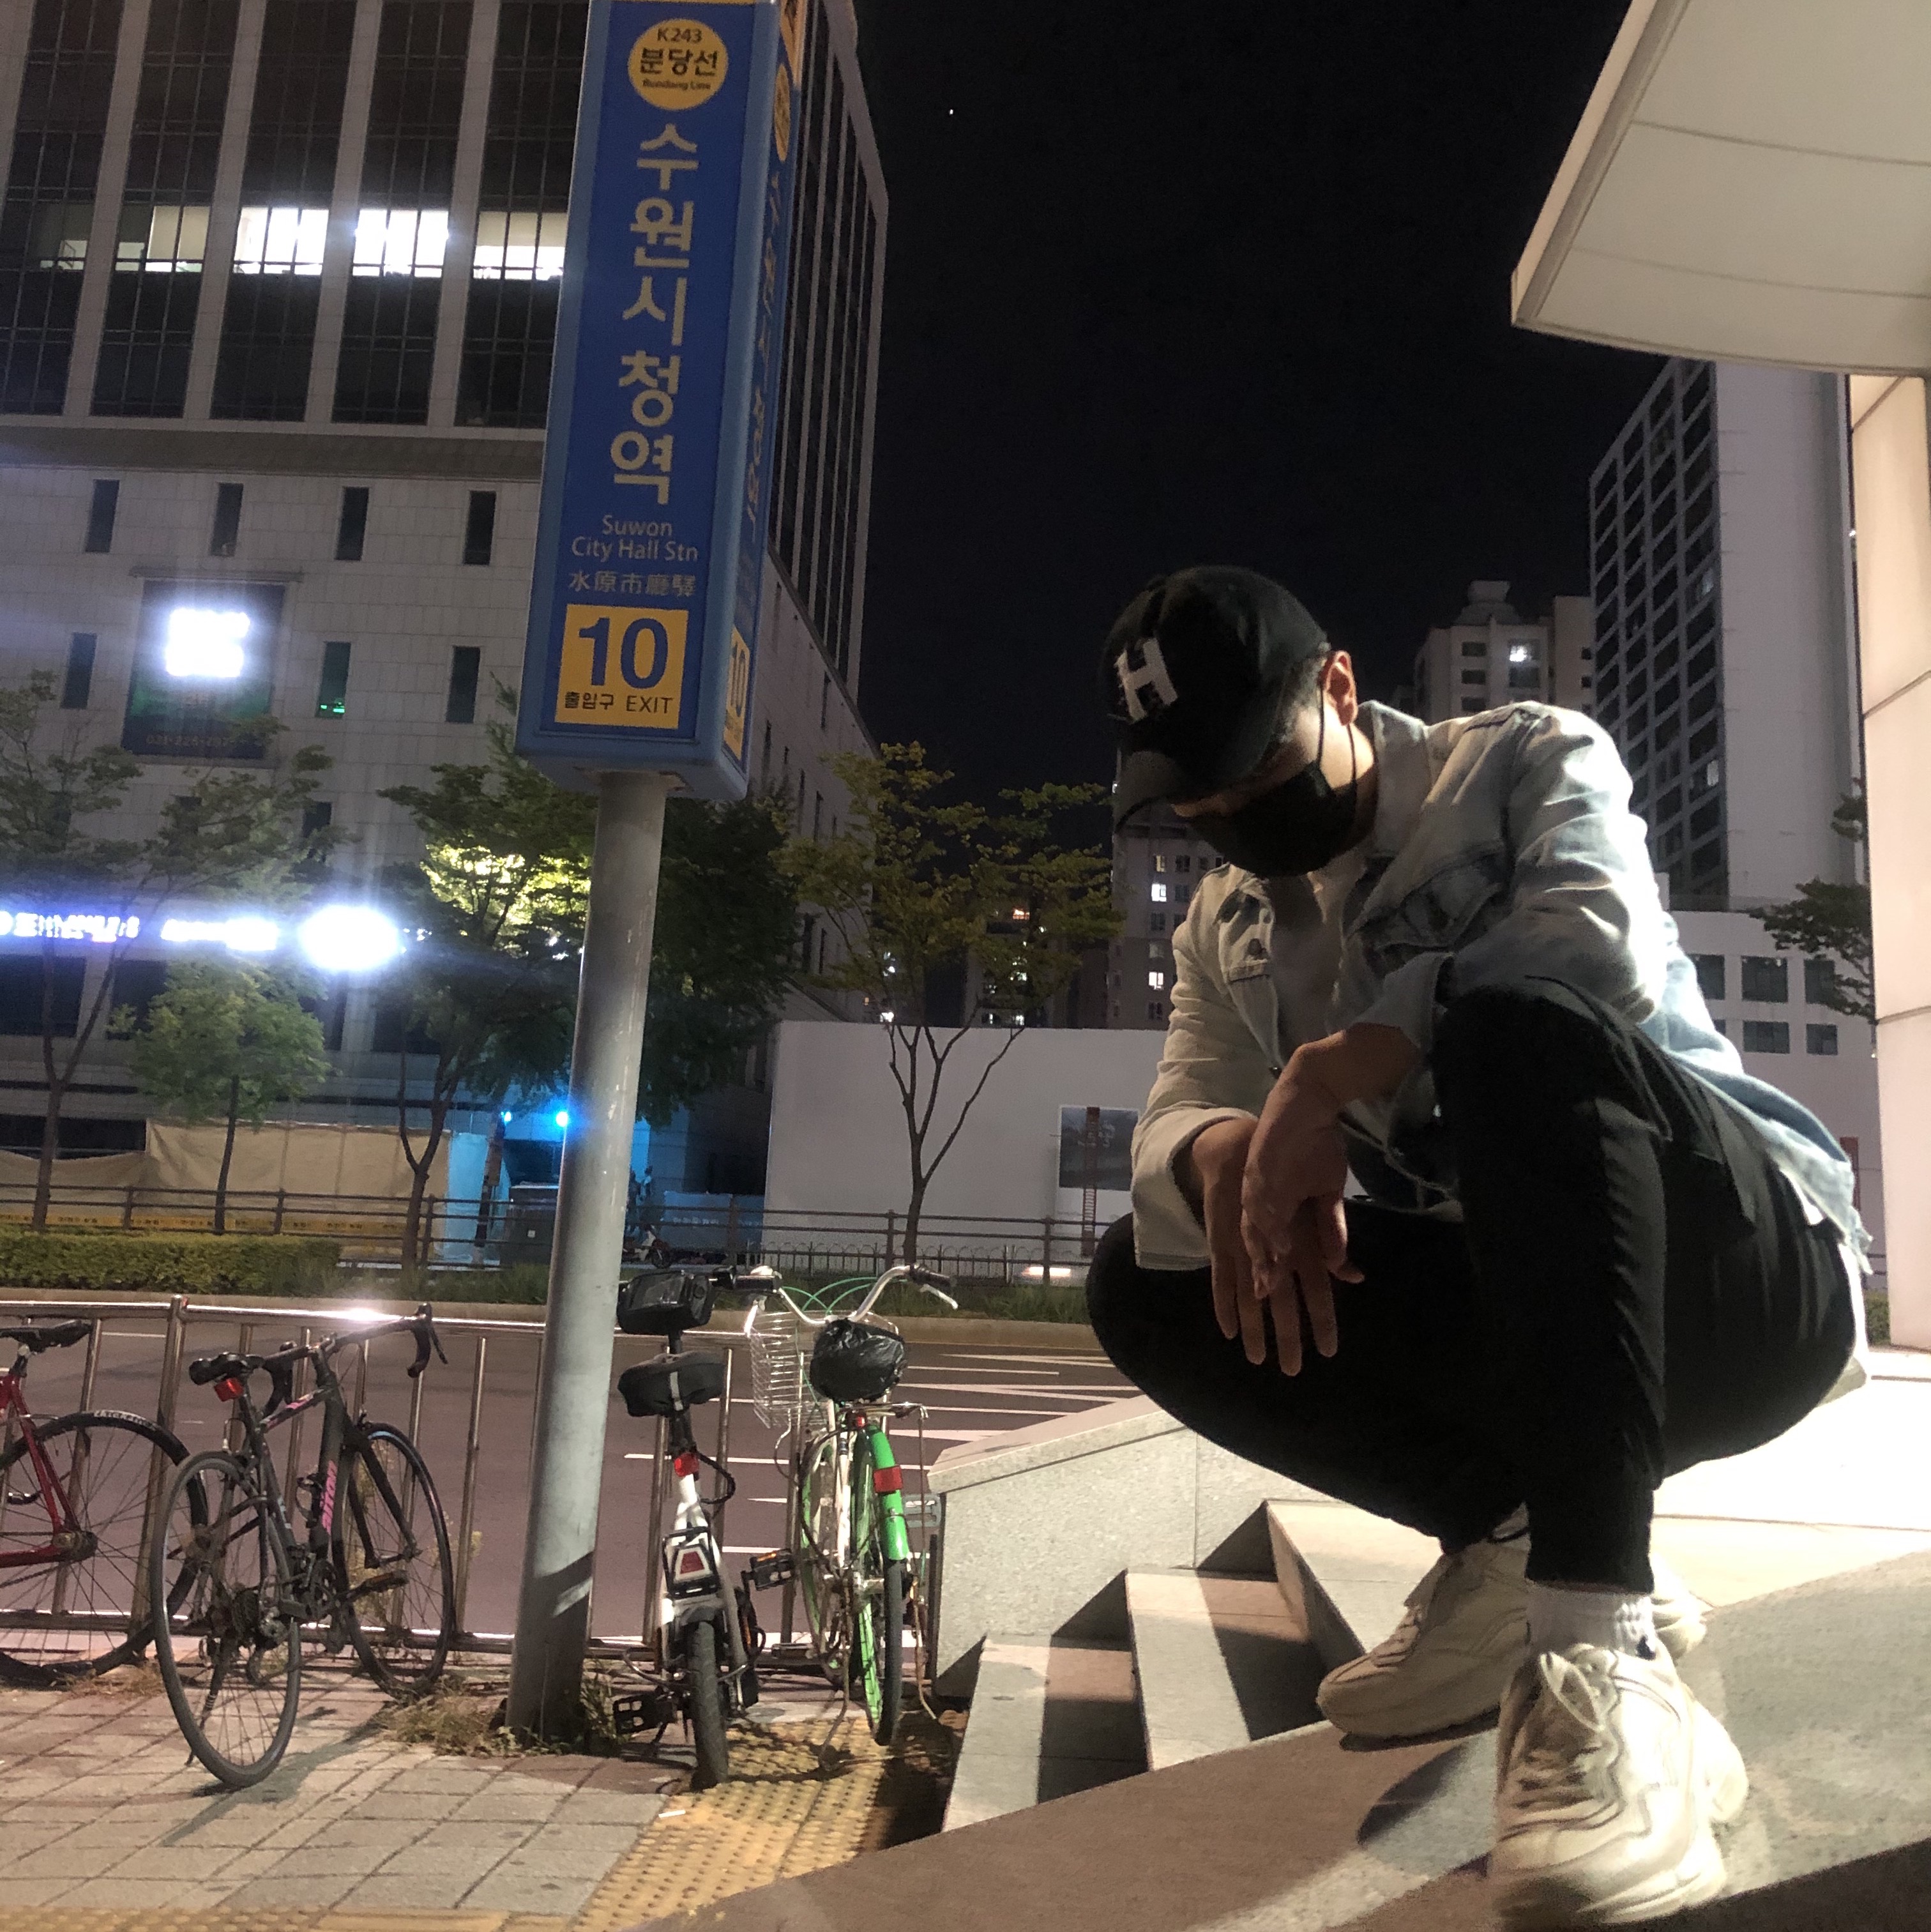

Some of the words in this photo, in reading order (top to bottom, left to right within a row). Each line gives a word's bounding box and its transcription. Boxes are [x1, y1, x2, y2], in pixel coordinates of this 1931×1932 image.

[657, 27, 702, 43] K243
[640, 47, 718, 76] 분당선
[610, 123, 699, 505] 수원시청역
[602, 514, 672, 536] Suwon
[572, 536, 613, 562] City
[618, 538, 660, 559] Hall
[664, 541, 698, 561] Stn
[579, 617, 669, 689] 10
[564, 691, 614, 710] 출입구
[626, 695, 674, 713] EXIT
